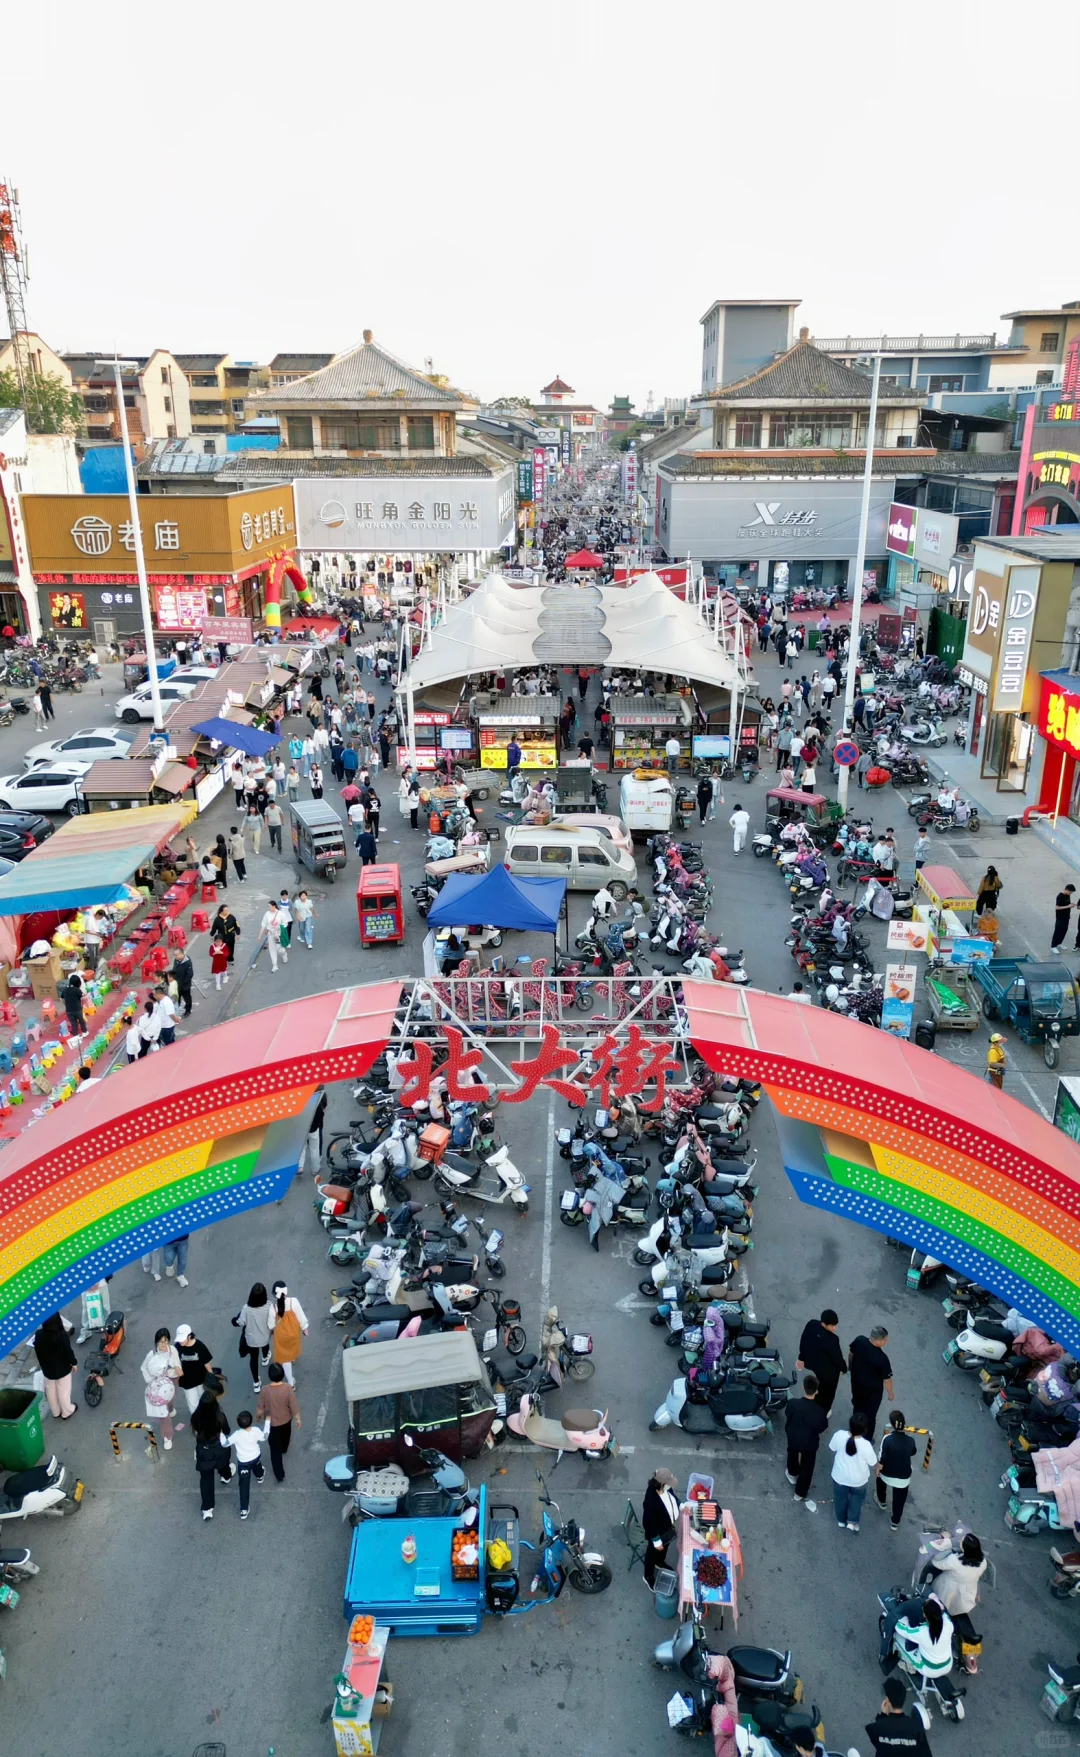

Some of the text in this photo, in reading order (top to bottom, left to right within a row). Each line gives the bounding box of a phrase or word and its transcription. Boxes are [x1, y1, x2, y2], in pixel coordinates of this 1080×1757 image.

[356, 501, 479, 520] 旺角金阳光
[779, 510, 820, 525] 特步
[411, 521, 453, 529] GOLDEN
[458, 521, 479, 529] SUN
[737, 527, 824, 538] 屡获全球跑鞋大奖
[118, 519, 180, 552] 老庙
[1000, 627, 1027, 693] 金豆豆
[396, 1023, 682, 1112] 北大街
